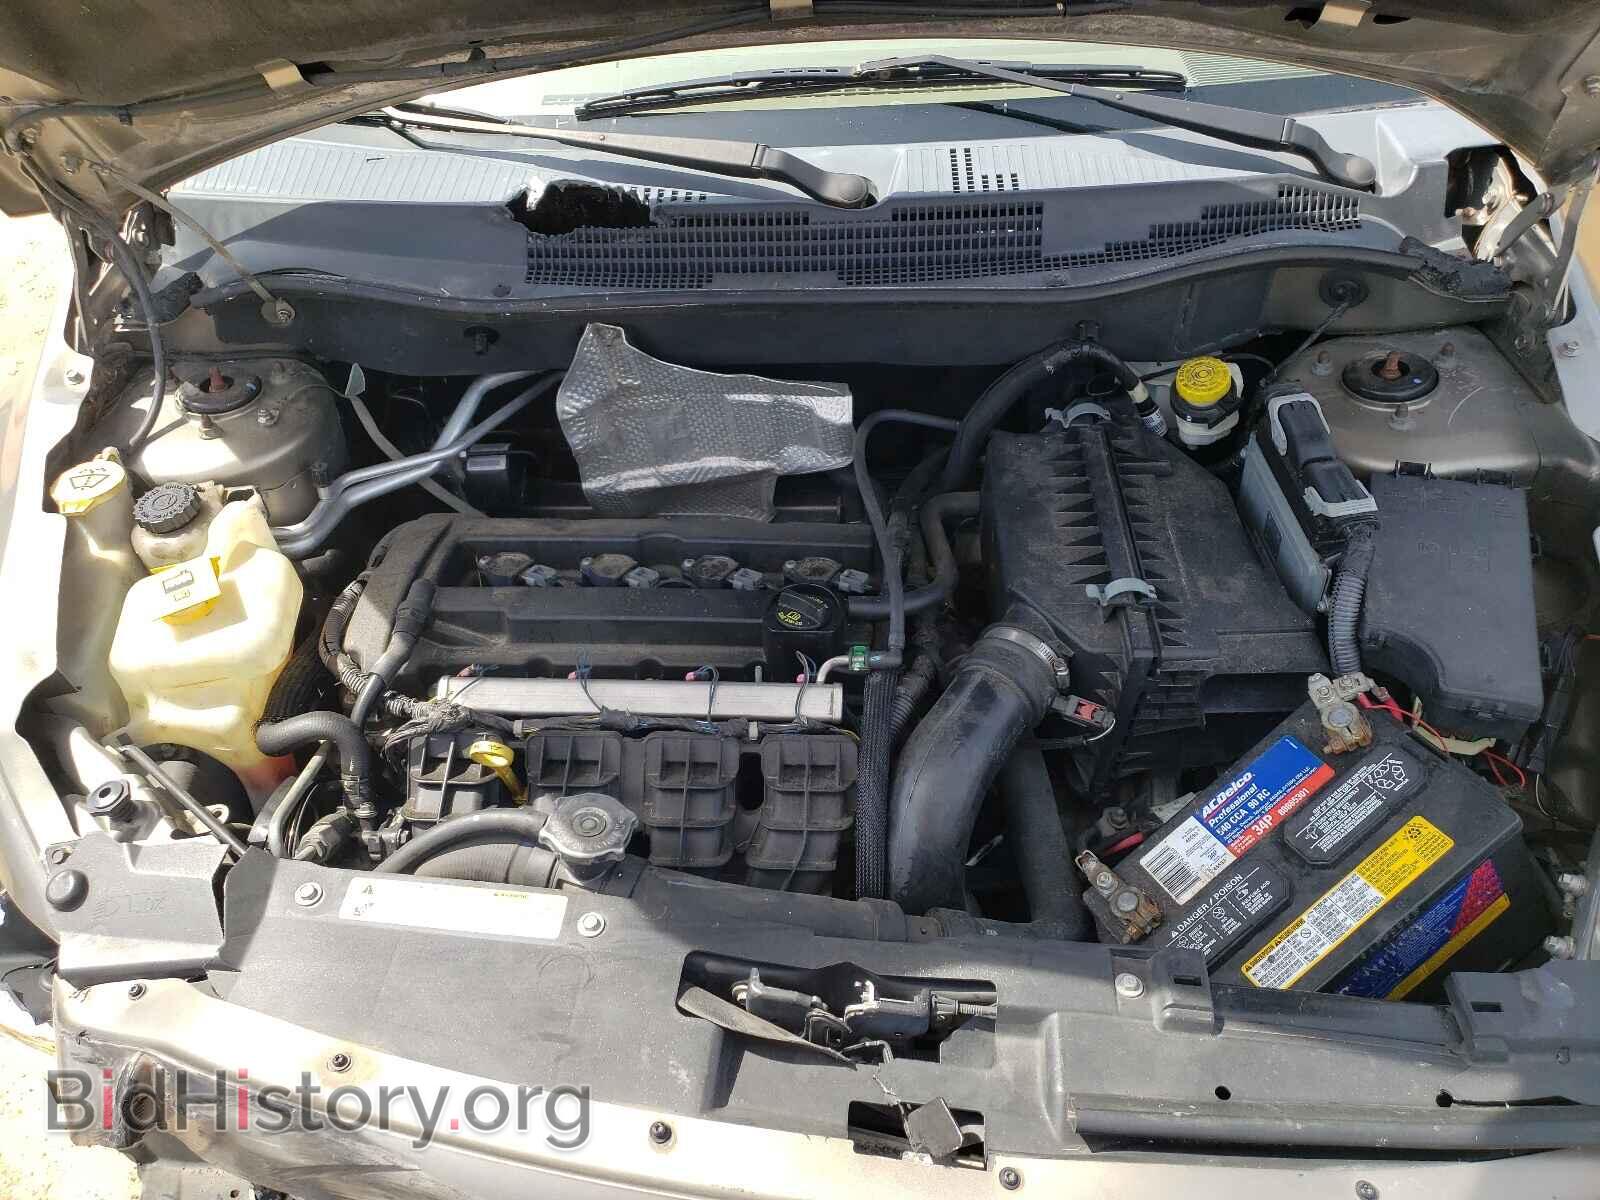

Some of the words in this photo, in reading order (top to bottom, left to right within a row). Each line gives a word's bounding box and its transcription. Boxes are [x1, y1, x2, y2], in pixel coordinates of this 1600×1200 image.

[1202, 772, 1254, 817] ACDelco
[1208, 783, 1257, 827] Professional
[1216, 821, 1232, 836] 540
[1229, 807, 1248, 824] CCA
[1256, 787, 1270, 801] RC
[1252, 813, 1274, 835] 34P
[1177, 903, 1208, 930] DANGER
[1214, 874, 1243, 900] POISON
